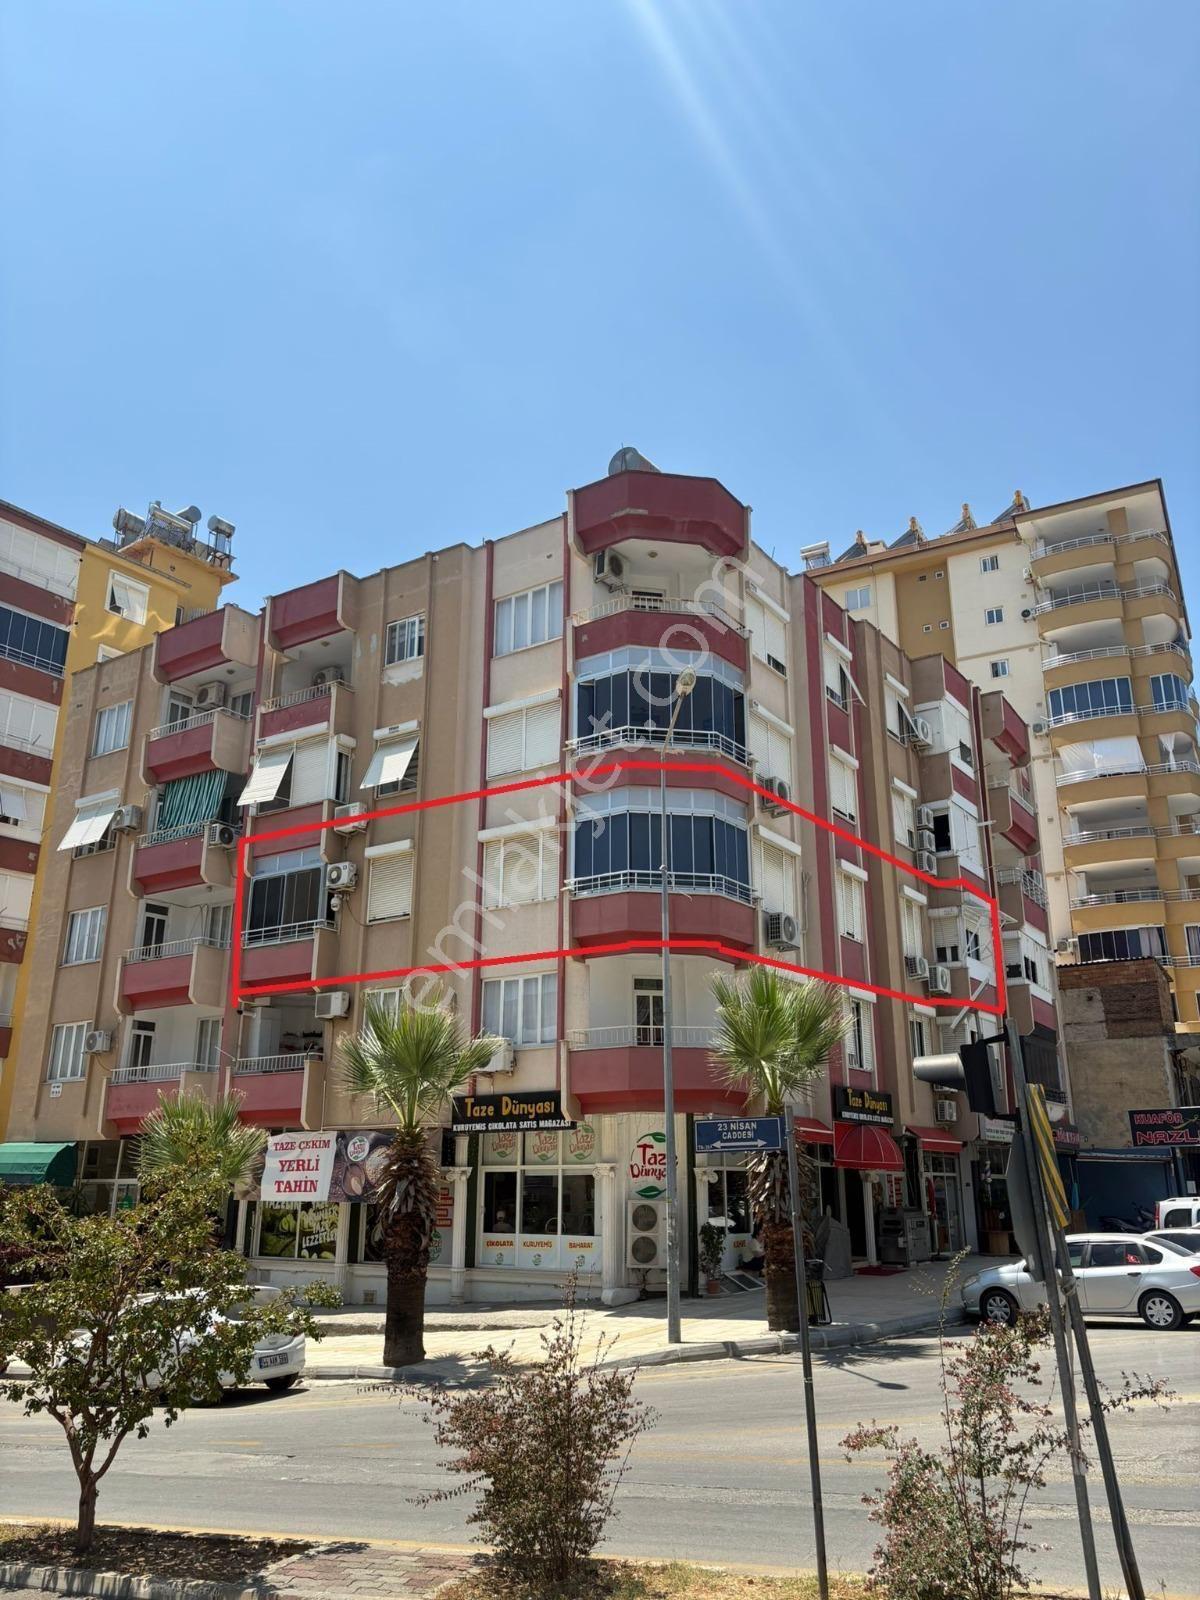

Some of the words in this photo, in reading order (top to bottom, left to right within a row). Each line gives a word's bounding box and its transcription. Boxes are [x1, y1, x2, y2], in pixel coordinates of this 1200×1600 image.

[847, 1087, 862, 1108] Taze
[465, 1097, 494, 1118] Taze
[501, 1096, 555, 1118] Dünyası
[1134, 1111, 1184, 1125] KUAFÖR
[717, 1123, 728, 1131] 23
[1136, 1129, 1200, 1145] NAZL
[273, 1141, 296, 1151] TAZE
[637, 1144, 678, 1166] Taz
[279, 1155, 320, 1172] YERLİ
[274, 1176, 318, 1192] TAHİN
